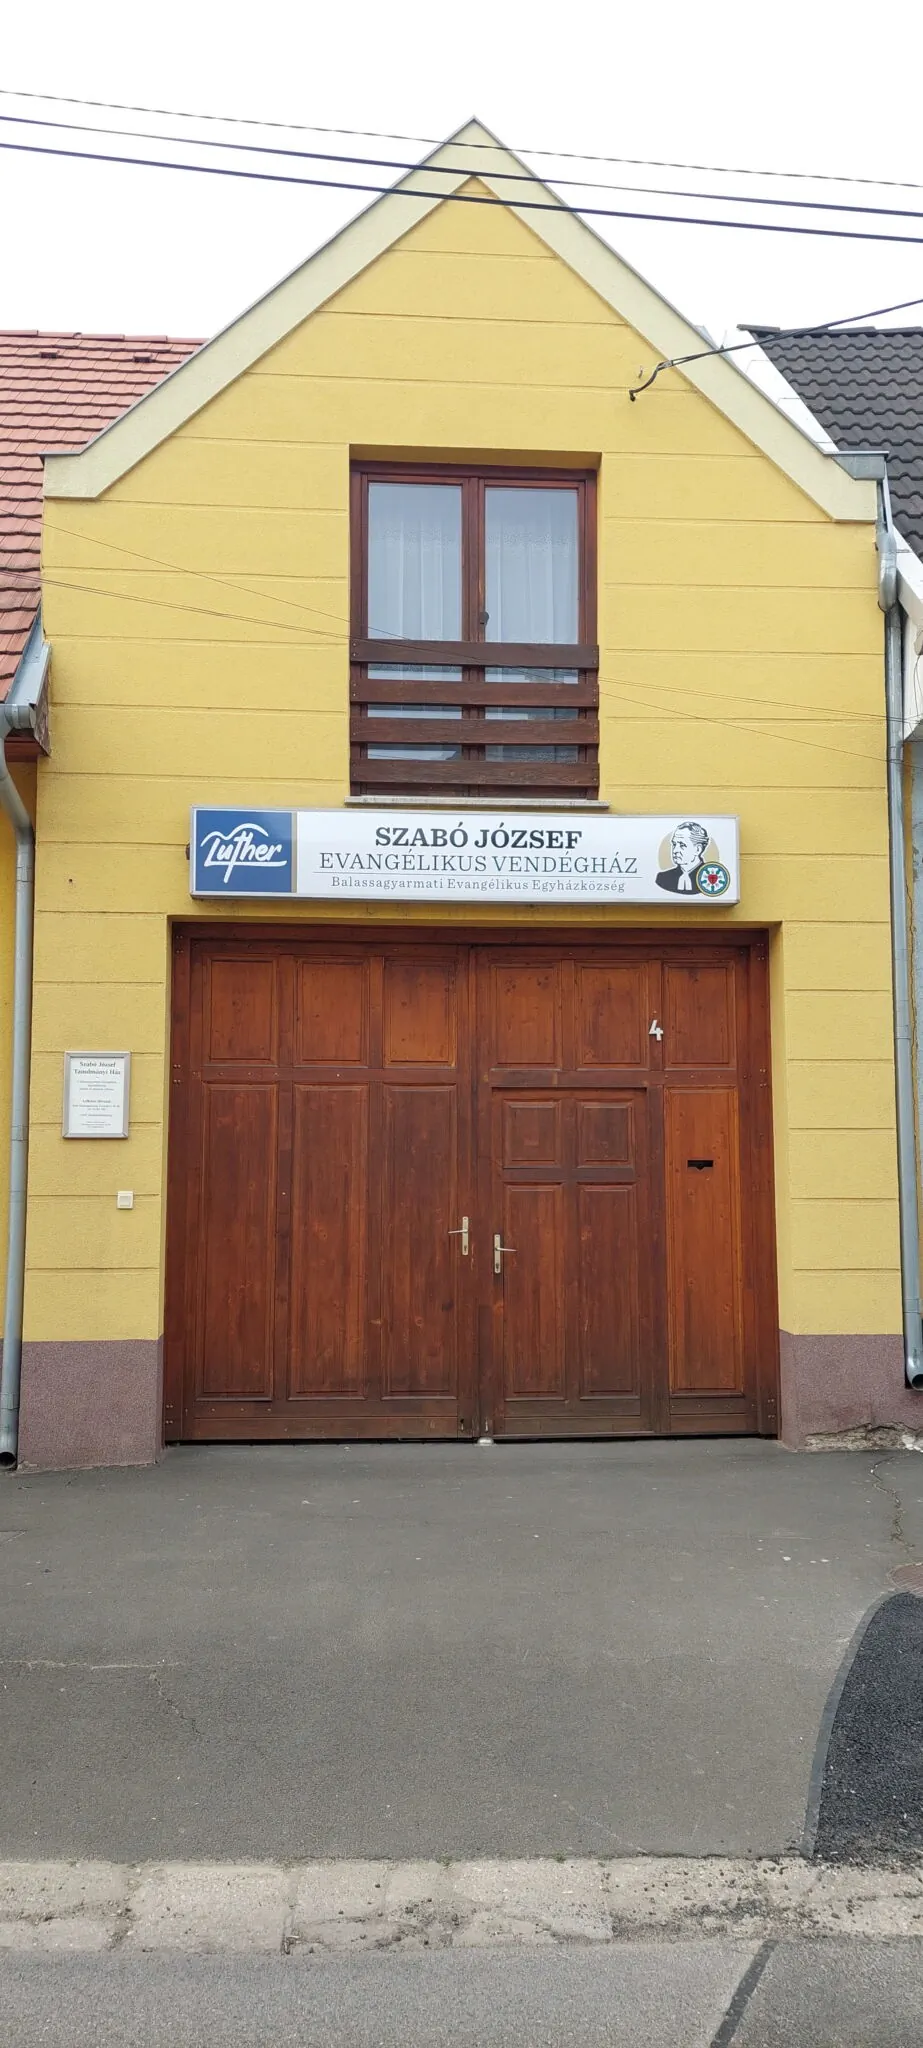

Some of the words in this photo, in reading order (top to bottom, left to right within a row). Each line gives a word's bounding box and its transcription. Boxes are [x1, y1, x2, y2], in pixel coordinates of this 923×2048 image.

[375, 822, 468, 848] SZABÓ
[474, 822, 582, 849] JÓZSEF
[201, 823, 287, 883] Luther
[319, 848, 487, 872] EVANGÉLIKUS
[492, 851, 638, 874] VENDÉGHÁZ
[331, 876, 443, 890] Balassagyarmati
[447, 877, 528, 891] Evangélikus
[532, 878, 625, 892] Egyházközség
[648, 1019, 664, 1041] 4
